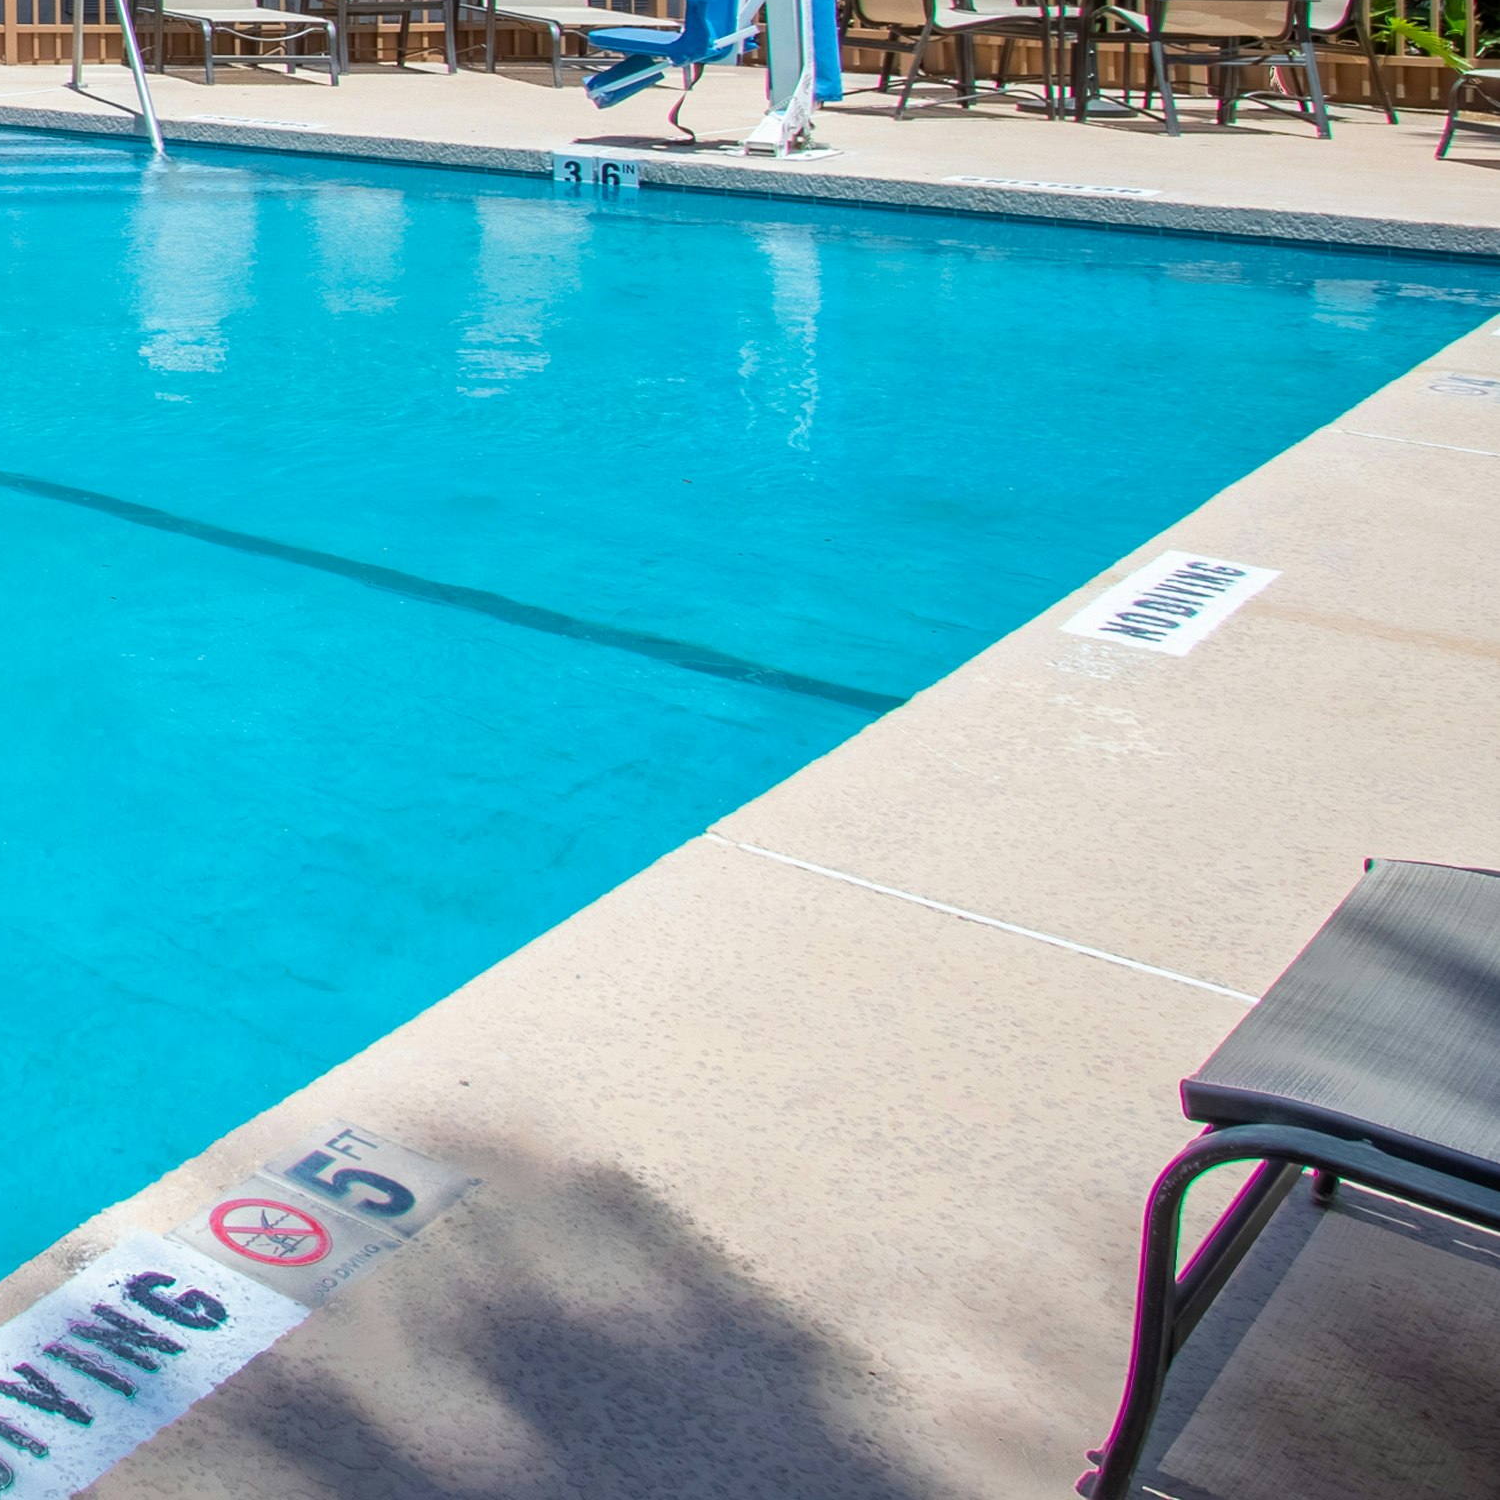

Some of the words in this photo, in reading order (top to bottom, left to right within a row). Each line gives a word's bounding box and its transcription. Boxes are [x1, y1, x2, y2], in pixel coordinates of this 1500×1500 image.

[564, 160, 582, 182] 3
[601, 162, 621, 186] 6
[622, 164, 635, 175] IN
[324, 1128, 378, 1161] FT
[284, 1150, 416, 1218] 5
